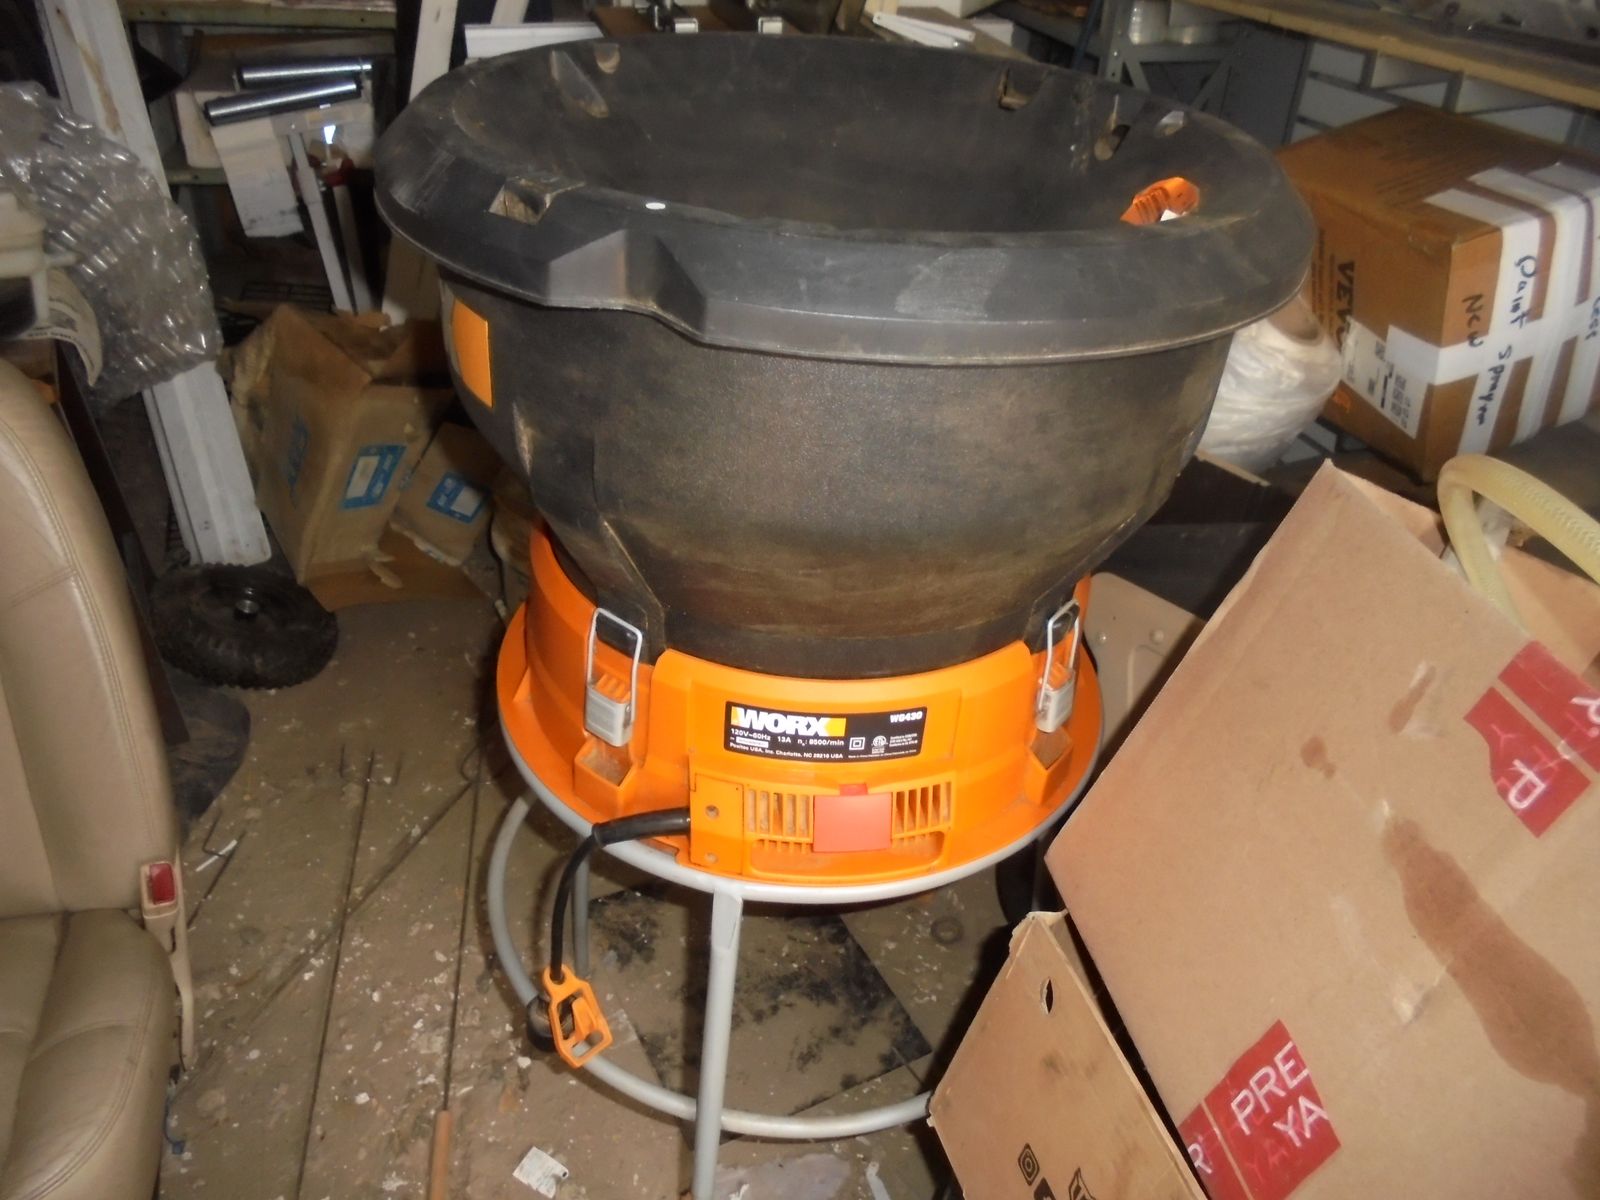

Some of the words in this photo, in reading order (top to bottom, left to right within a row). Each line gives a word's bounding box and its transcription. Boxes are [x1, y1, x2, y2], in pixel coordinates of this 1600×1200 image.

[1461, 293, 1485, 348] New
[736, 706, 829, 738] WORX
[777, 735, 792, 744] 13A
[830, 752, 844, 760] USA
